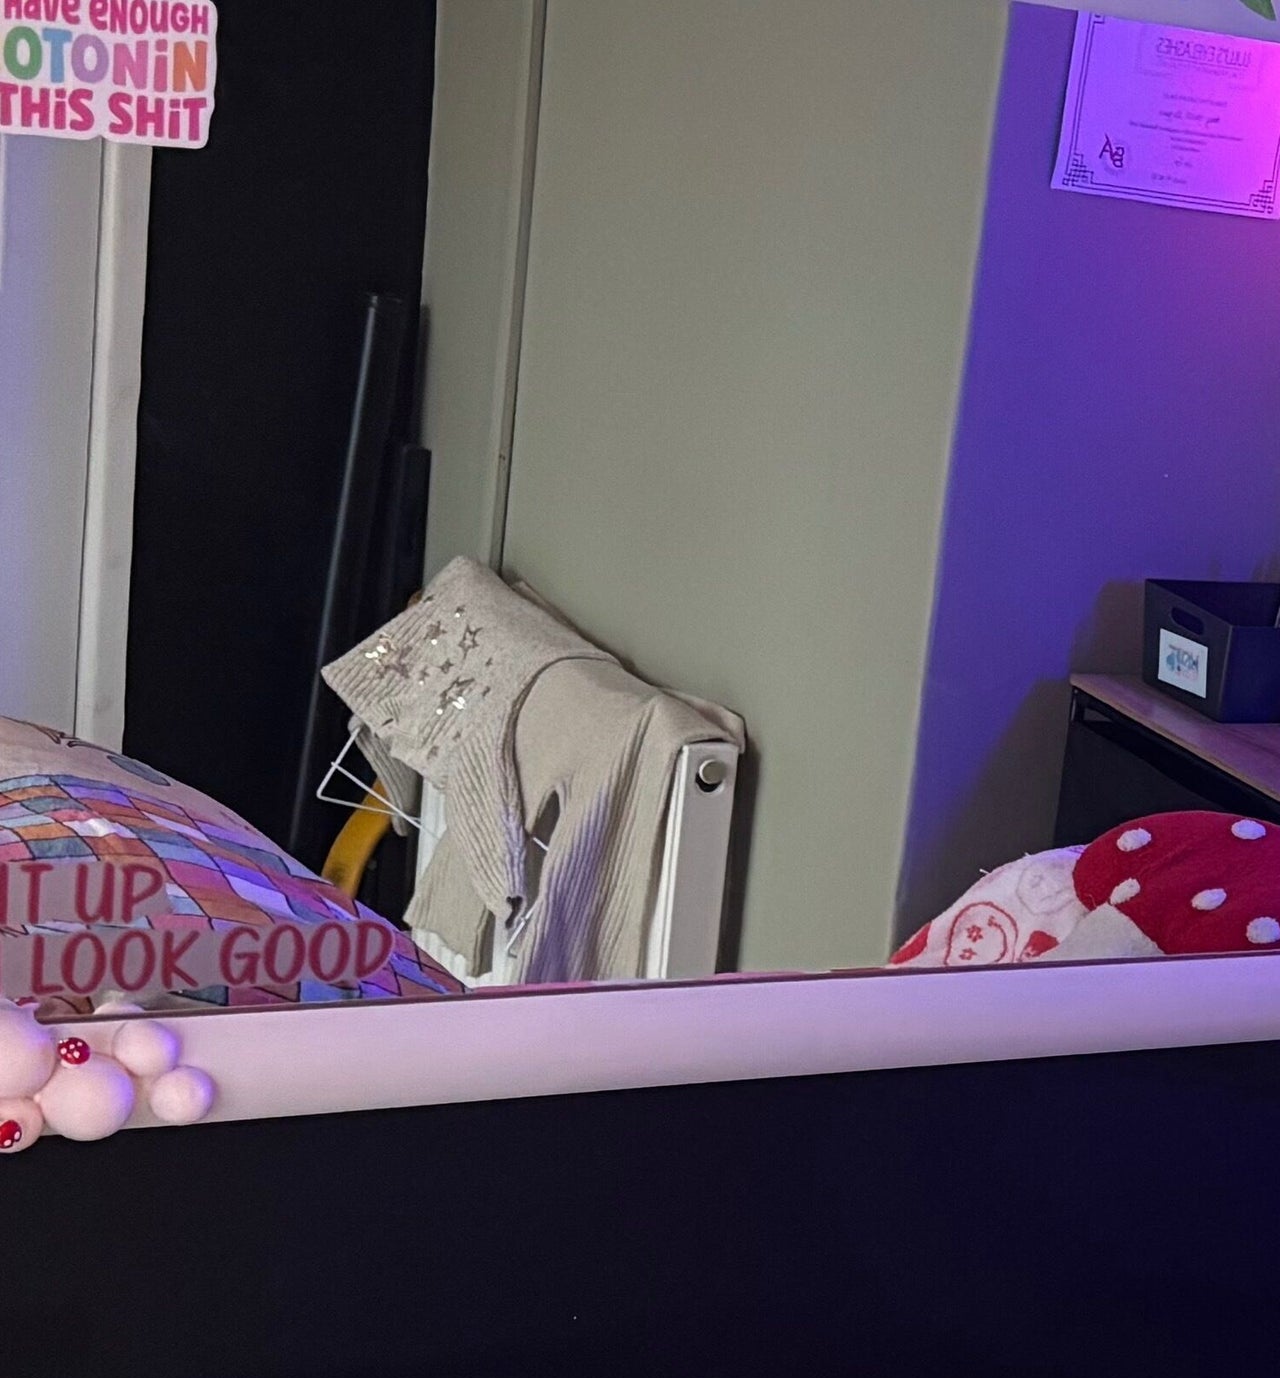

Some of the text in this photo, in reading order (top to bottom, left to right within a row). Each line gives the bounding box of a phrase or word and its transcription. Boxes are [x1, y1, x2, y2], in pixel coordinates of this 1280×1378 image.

[74, 862, 164, 924] UP
[30, 920, 395, 996] LOOK GOOD
